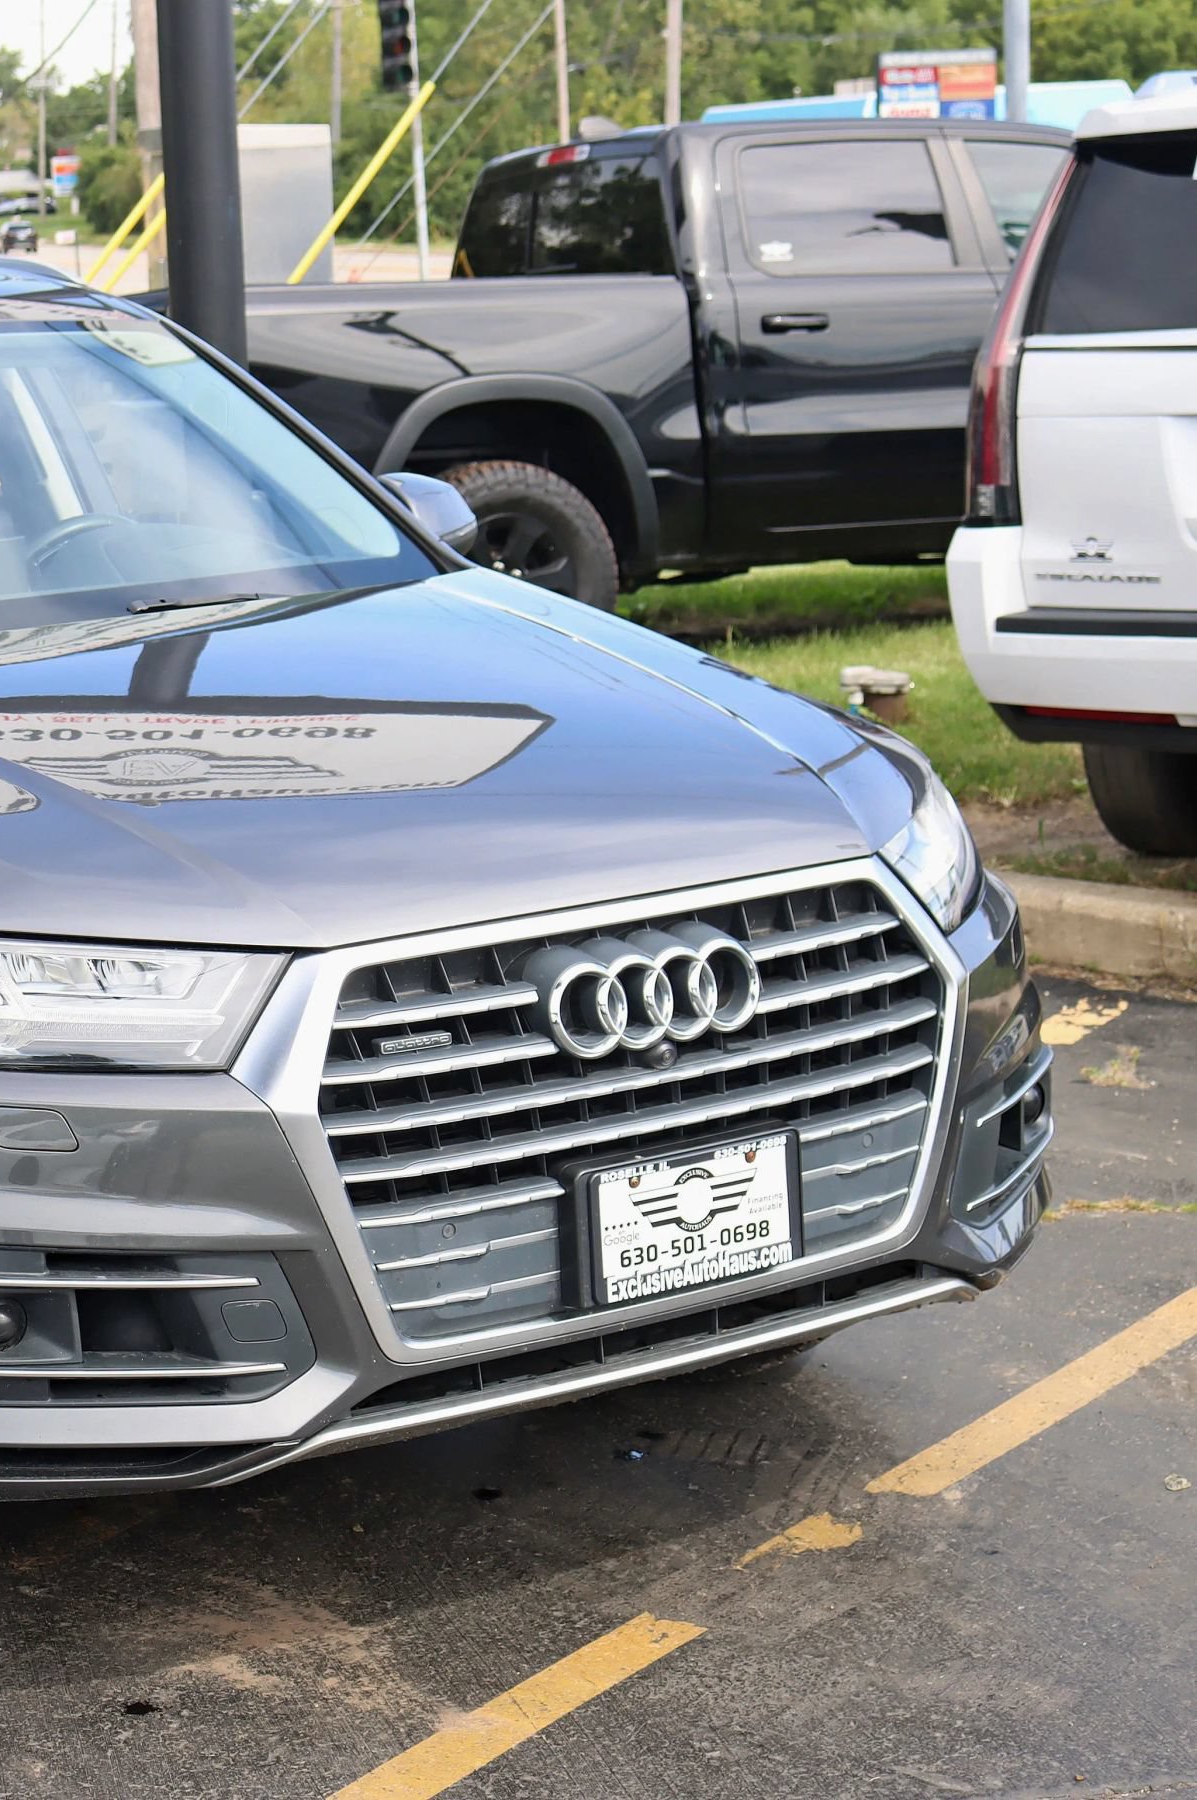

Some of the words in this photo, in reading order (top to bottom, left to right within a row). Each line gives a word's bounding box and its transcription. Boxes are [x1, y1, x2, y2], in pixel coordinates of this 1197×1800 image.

[714, 1135, 787, 1160] 630-501-0698
[600, 1163, 657, 1184] ROSELLE,
[659, 1161, 671, 1171] IL
[678, 1168, 710, 1185] EXCLUSIVE
[679, 1214, 713, 1232] AUTOHAUS
[603, 1230, 641, 1247] Google
[619, 1219, 771, 1269] 630-501-0698
[606, 1240, 793, 1305] ExclusiveAutoHaus.com
